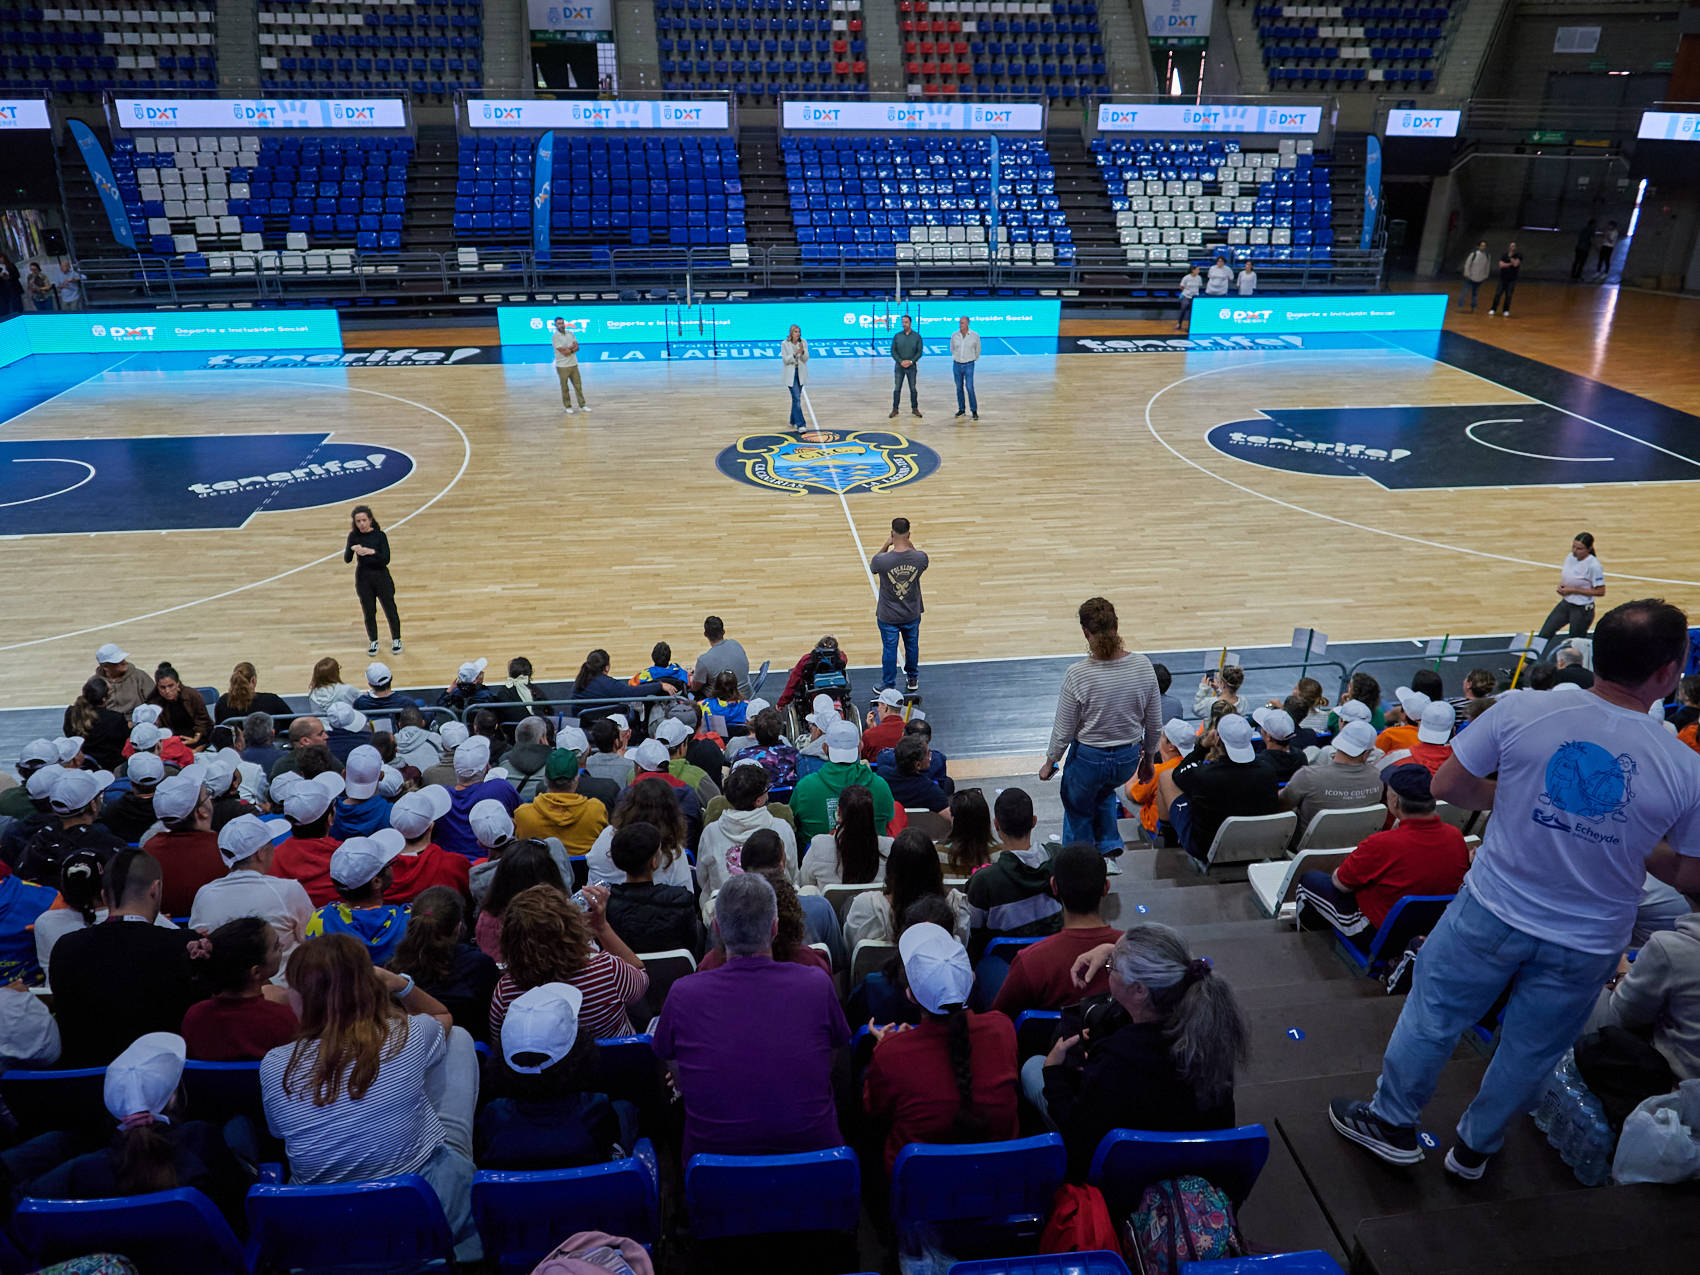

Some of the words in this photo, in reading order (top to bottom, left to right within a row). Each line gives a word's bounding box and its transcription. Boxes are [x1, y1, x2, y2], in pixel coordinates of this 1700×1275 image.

[563, 7, 592, 19] DXT
[1168, 15, 1197, 27] DXT
[146, 107, 178, 119] DXT
[245, 107, 276, 119] DXT
[345, 107, 375, 119] DXT
[494, 107, 522, 119] DXT
[583, 107, 611, 119] DXT
[674, 108, 703, 120] DXT
[813, 109, 840, 120] DXT
[897, 110, 924, 121] DXT
[985, 110, 1012, 122] DXT
[1111, 111, 1138, 123] DXT
[1193, 112, 1220, 124] DXT
[1279, 113, 1307, 125] DXT
[1413, 116, 1443, 128] DXT
[859, 314, 901, 324] DXT
[1233, 310, 1273, 319] DXT
[109, 326, 156, 336] DXT
[600, 350, 645, 361] LA
[661, 346, 785, 359] LAGUN
[1305, 448, 1386, 461] emociones
[287, 466, 372, 485] emociones
[1325, 789, 1349, 797] ICONO
[1575, 822, 1620, 845] Echeyde
[1420, 1132, 1436, 1147] 8
